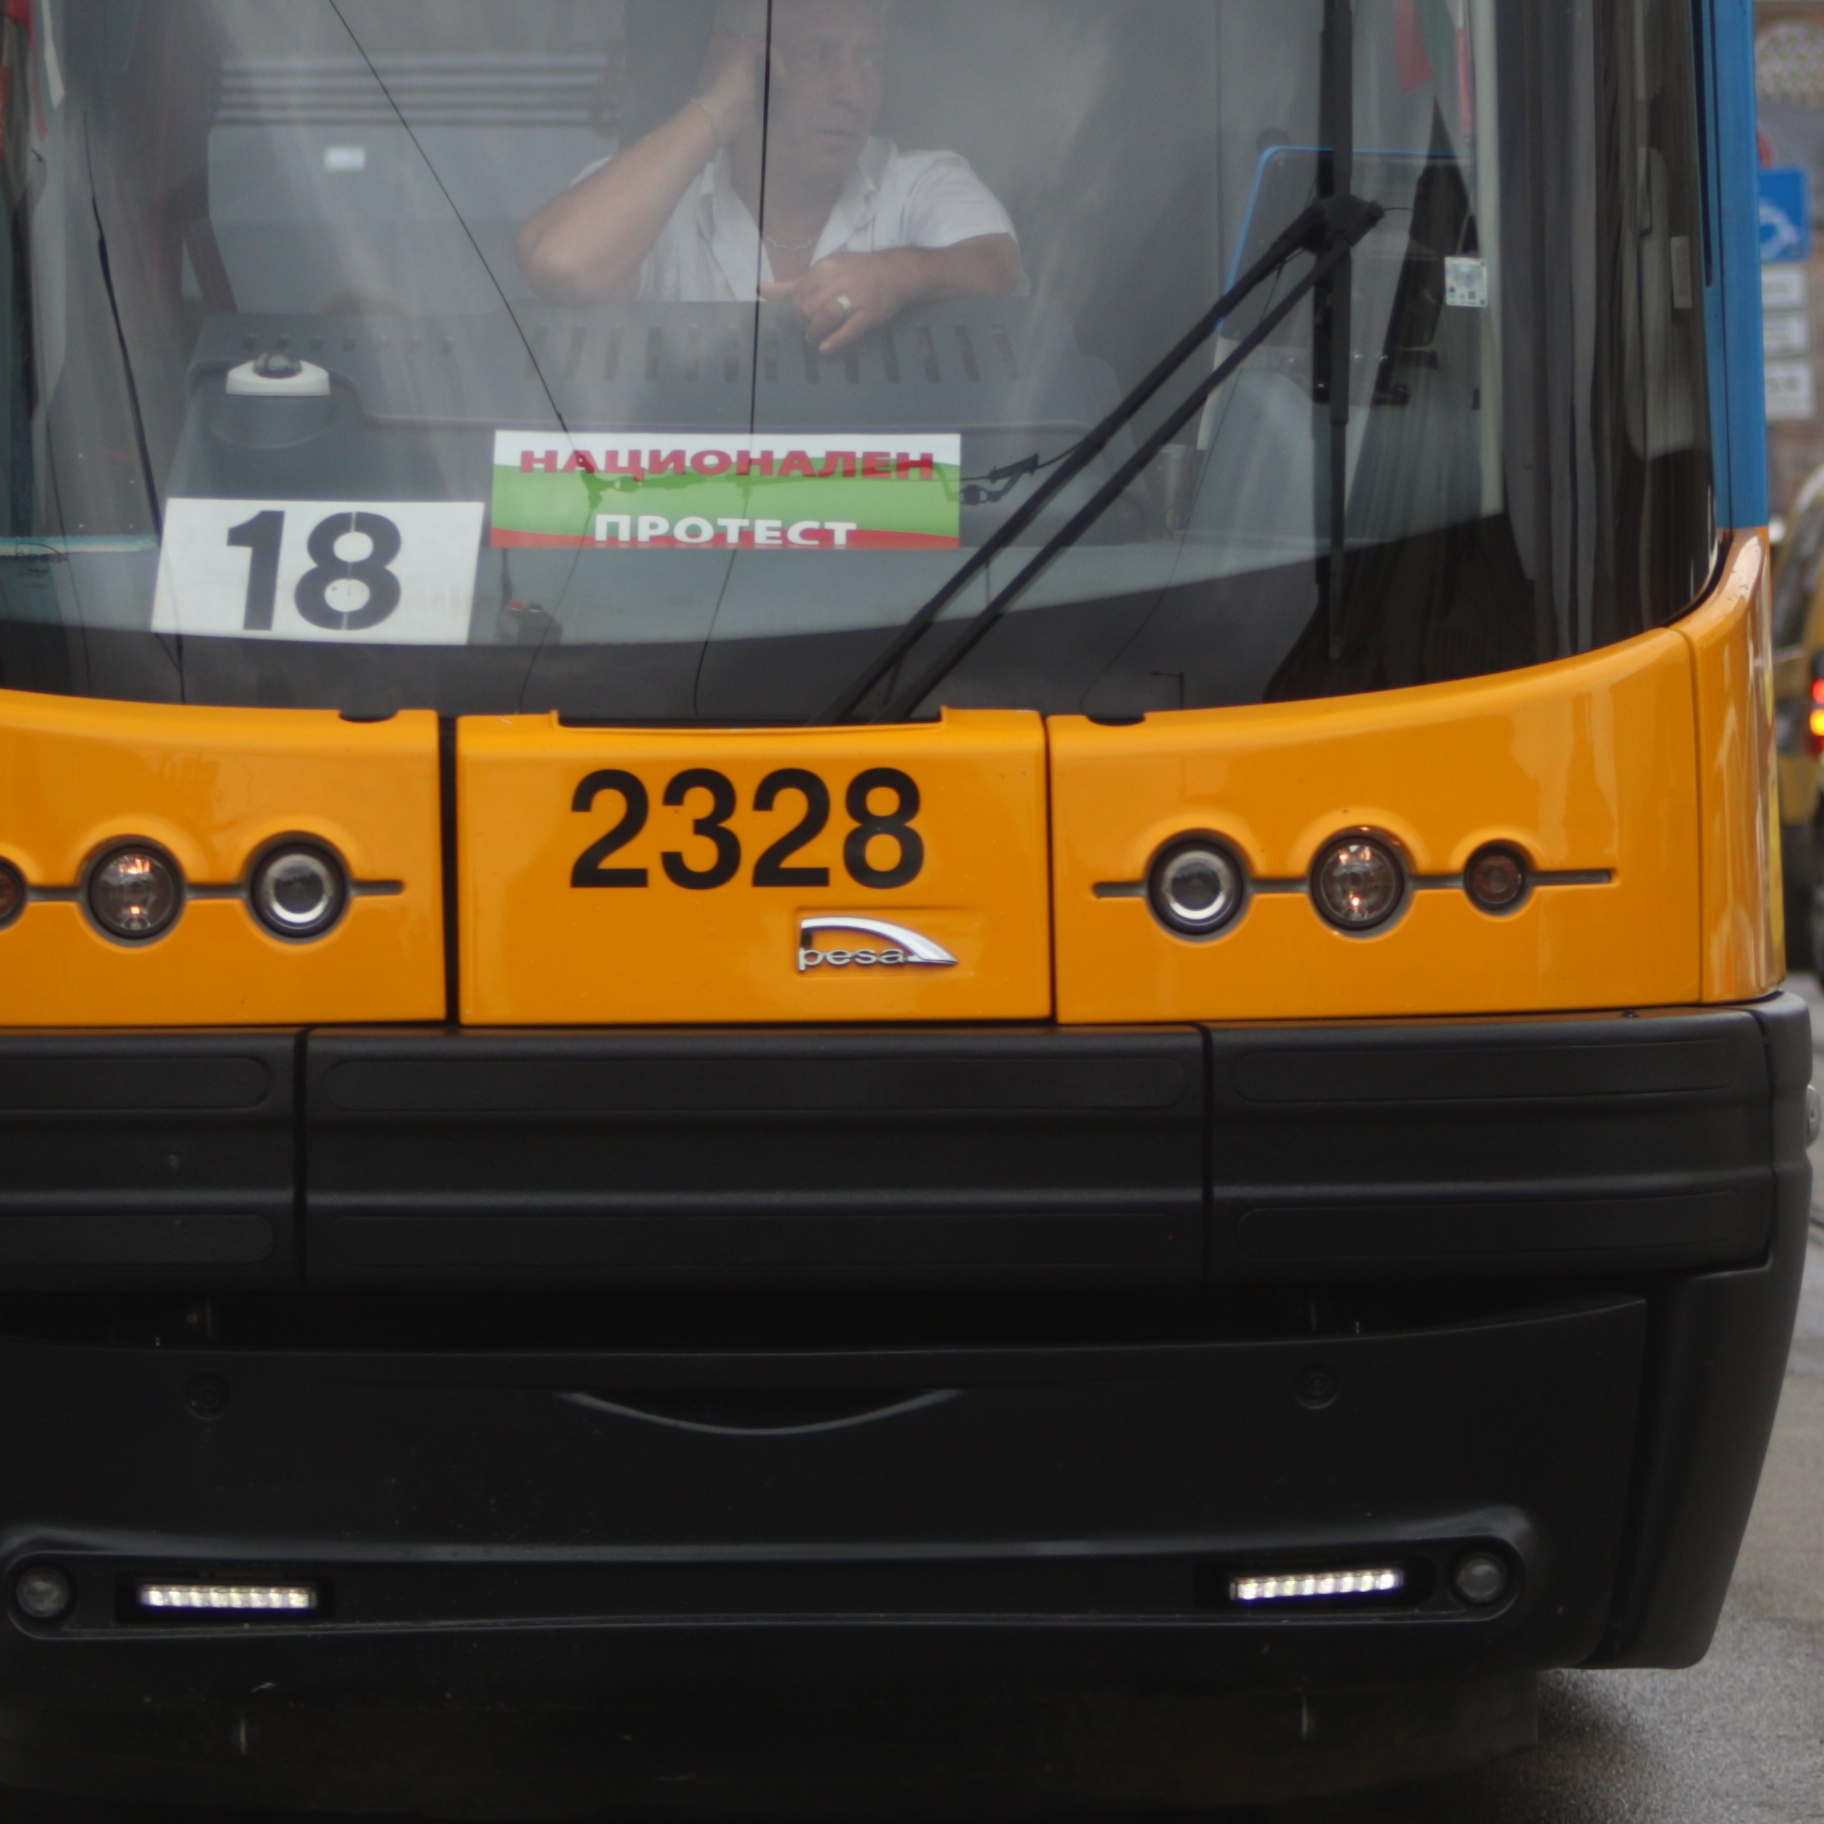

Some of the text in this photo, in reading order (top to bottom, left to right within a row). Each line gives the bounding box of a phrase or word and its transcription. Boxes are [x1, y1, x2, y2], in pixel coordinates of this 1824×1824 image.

[519, 449, 934, 481] НАЦИОНАЛЕН
[594, 513, 858, 547] ПРОТЕСТ
[226, 510, 402, 631] 18
[570, 766, 925, 890] 2328
[798, 947, 906, 973] pesa
